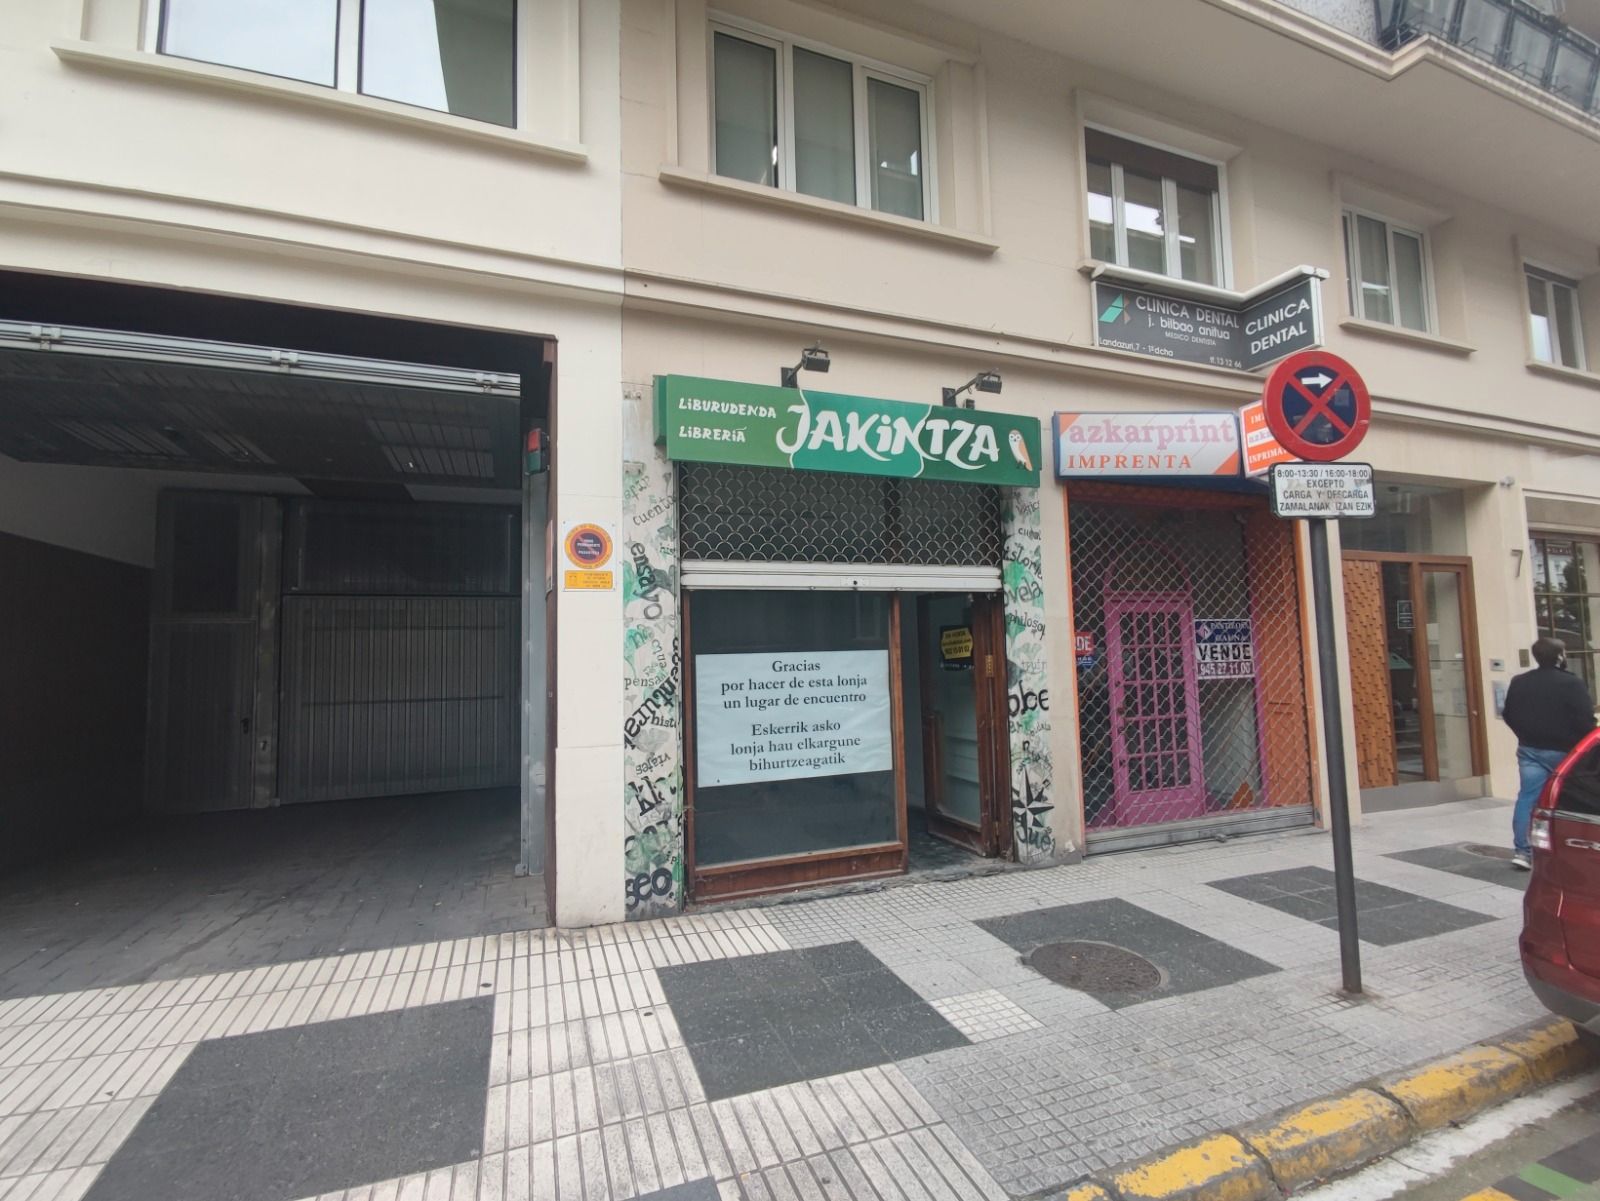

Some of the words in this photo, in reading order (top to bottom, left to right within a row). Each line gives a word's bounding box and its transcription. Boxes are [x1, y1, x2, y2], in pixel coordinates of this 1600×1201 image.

[1135, 296, 1190, 319] CLINICA
[1196, 308, 1240, 329] DENTAL
[1245, 298, 1311, 336] CLINICA
[1160, 316, 1194, 333] bilbao
[1199, 326, 1230, 340] anitua
[1191, 336, 1216, 346] DENTISTA
[1251, 322, 1308, 355] DENTAL
[1068, 418, 1237, 450] azkarprint
[1067, 455, 1192, 470] IMPRENTA
[1277, 469, 1319, 478] 8:00-13:30
[1306, 479, 1345, 488] EXCEPTO
[1283, 490, 1312, 500] CARGA
[1317, 490, 1322, 499] Y
[1327, 490, 1369, 500] DESCARGA
[1280, 502, 1331, 512] ZAMALANAK
[1335, 502, 1354, 511] IZAN
[1356, 502, 1373, 512] EZIK
[1511, 548, 1523, 577] 7
[1199, 644, 1251, 661] VENDE
[772, 660, 821, 673] Gracias
[721, 682, 744, 696] por
[748, 678, 786, 691] hacer
[789, 677, 805, 689] de
[808, 677, 833, 688] esta
[837, 674, 868, 689] lonja
[723, 699, 741, 710] un
[745, 696, 780, 711] lugar
[784, 694, 800, 706] de
[803, 692, 866, 705] encuentro
[751, 721, 808, 736] Eskerrik
[812, 720, 841, 732] asko
[730, 743, 764, 758] lonja
[768, 740, 793, 754] hau
[797, 737, 861, 752] elkargune
[749, 753, 846, 771] bihurtzeagatik
